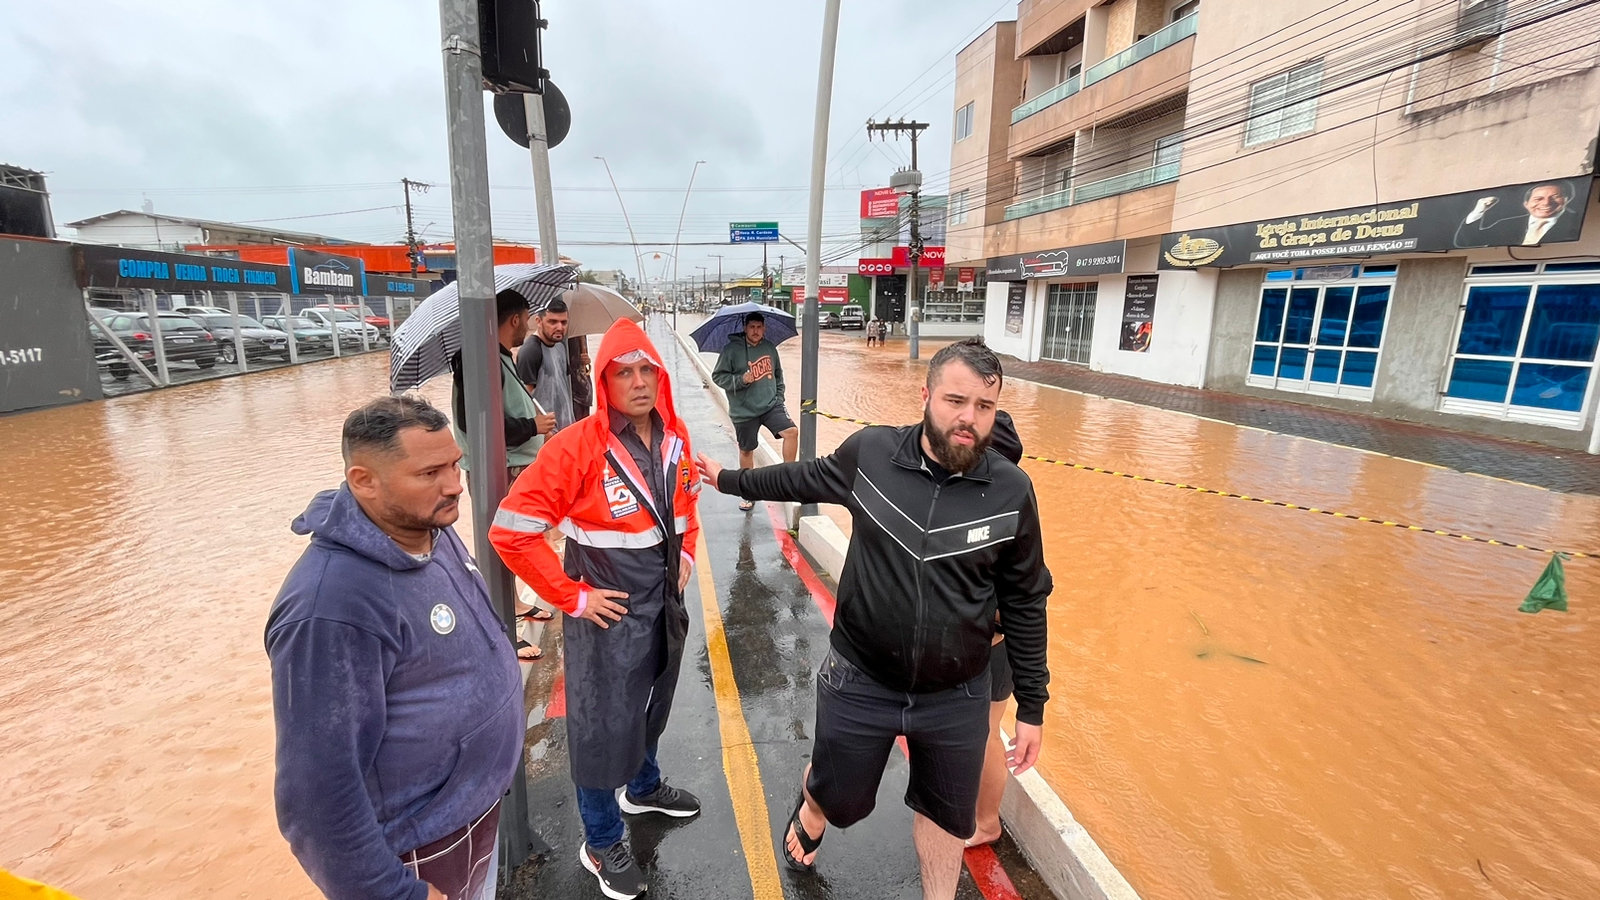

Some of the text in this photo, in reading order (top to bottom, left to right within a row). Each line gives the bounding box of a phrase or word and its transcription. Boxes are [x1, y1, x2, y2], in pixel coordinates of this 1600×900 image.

[1255, 203, 1419, 237] Igreja Internacional
[1260, 224, 1404, 249] da Graça de Deus
[1255, 252, 1271, 260] AQUI
[1272, 250, 1289, 258] VOCÊ
[1336, 246, 1347, 254] DA
[1349, 244, 1365, 253] SUA
[119, 258, 277, 286] COMPRA VENDA TROCA FINANCIA
[304, 267, 354, 287] Bambam
[967, 525, 990, 544] NIKE
